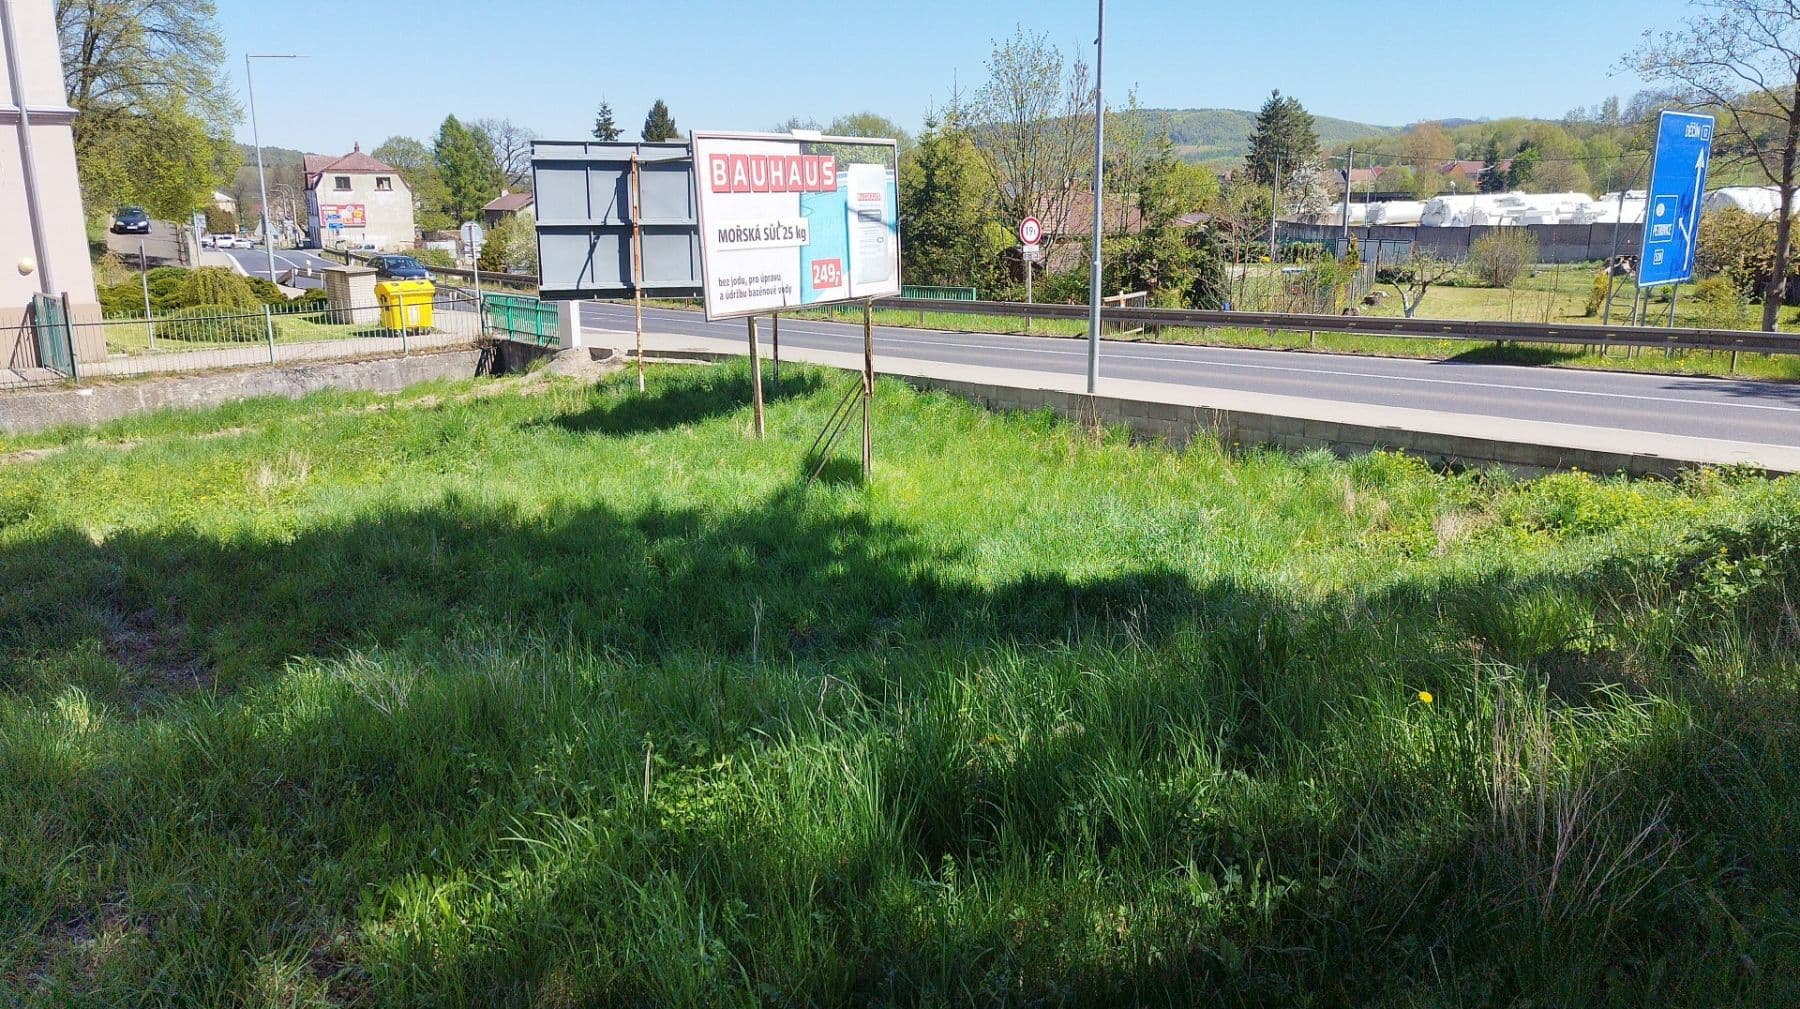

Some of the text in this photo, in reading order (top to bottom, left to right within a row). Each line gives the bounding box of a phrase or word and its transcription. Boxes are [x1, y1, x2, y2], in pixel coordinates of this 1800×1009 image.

[711, 157, 835, 189] BAUHAUS
[718, 224, 761, 243] MOŘSKÁ
[783, 226, 793, 240] 25
[795, 225, 807, 242] kg
[718, 276, 730, 287] bez
[748, 275, 760, 286] pro
